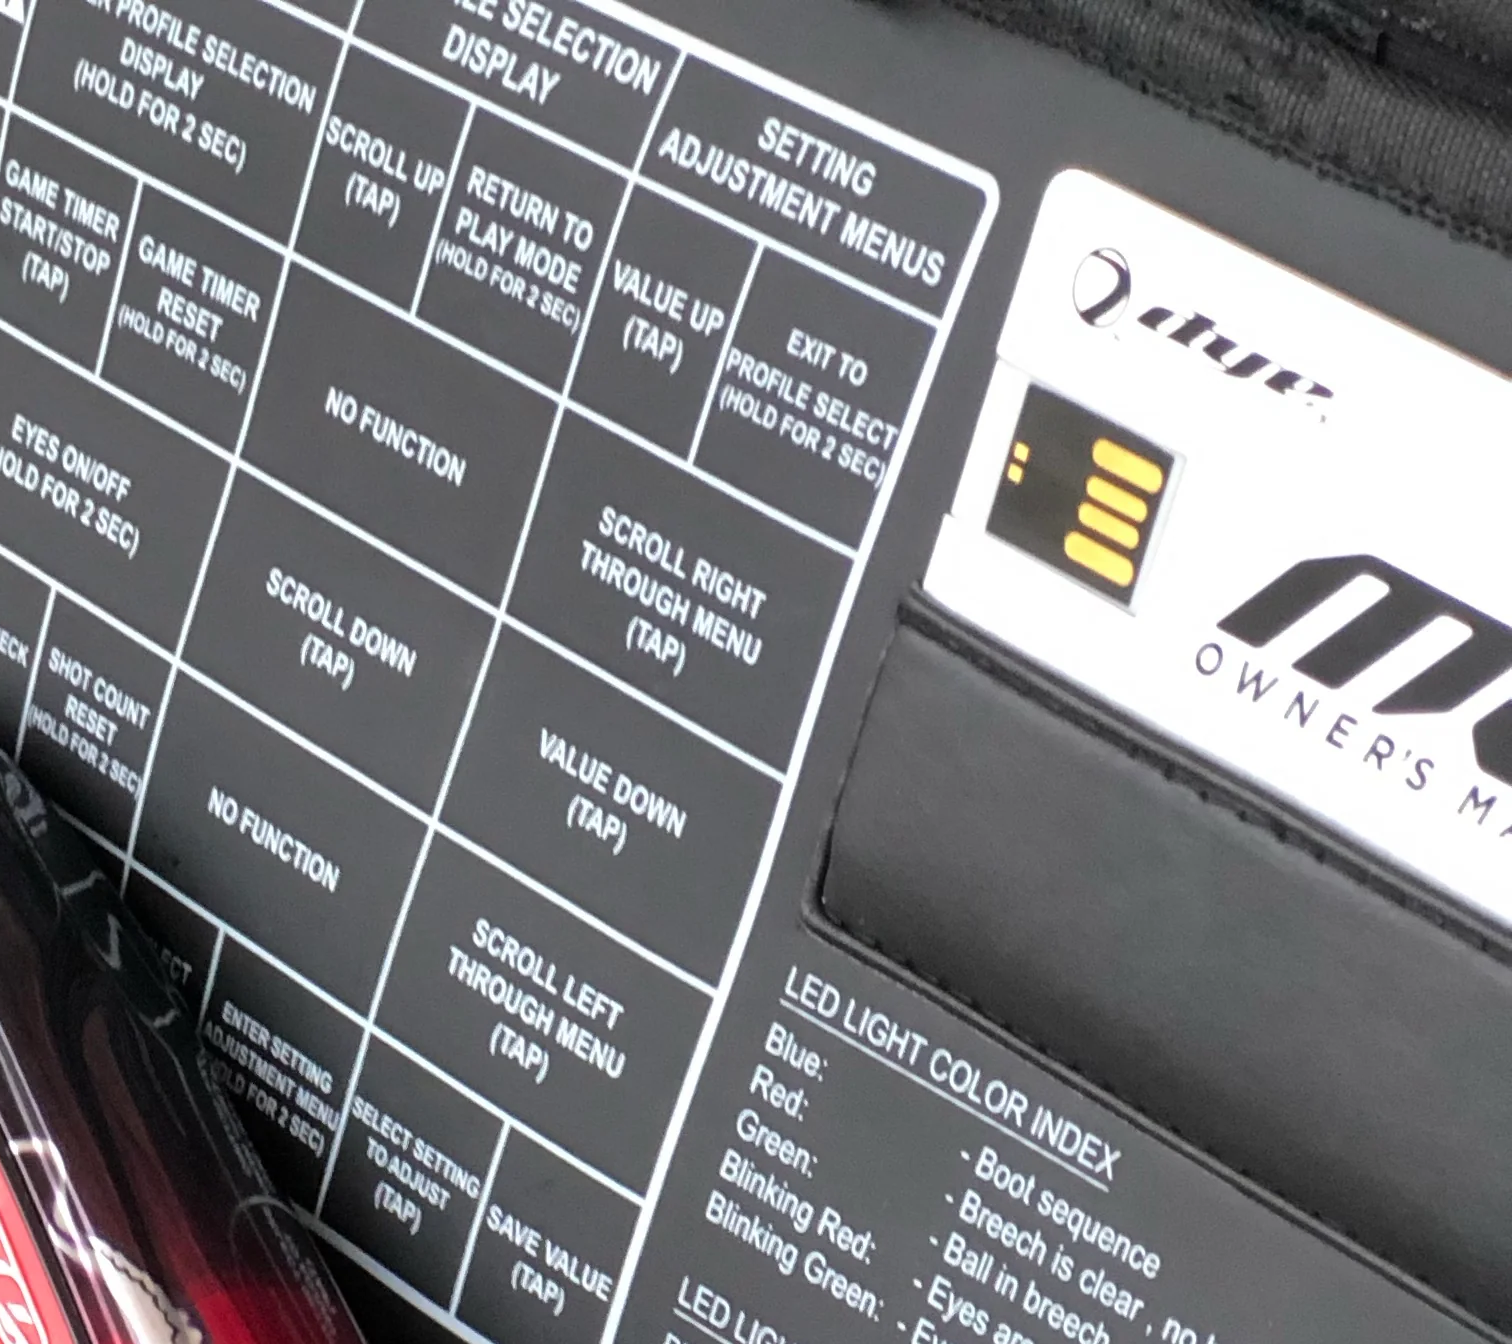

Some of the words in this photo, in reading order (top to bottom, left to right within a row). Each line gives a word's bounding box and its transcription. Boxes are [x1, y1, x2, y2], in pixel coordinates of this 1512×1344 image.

[115, 0, 201, 56] PROFILE
[201, 35, 317, 114] SELECTION
[119, 36, 204, 102] DISPLAY
[442, 24, 561, 105] DISPLAY
[502, 0, 661, 95] SELECTION
[73, 58, 134, 111] (HOLD
[136, 91, 180, 137] FOR
[180, 114, 196, 142] 2
[197, 119, 248, 174] SEC)
[325, 116, 409, 183] SCROLL
[413, 160, 445, 197] UP
[757, 117, 878, 197] SETTING
[0, 197, 111, 276] START/STOP
[5, 159, 58, 210] GAME
[63, 188, 120, 243] TIMER
[345, 172, 400, 228] (TAP)
[467, 166, 558, 234] RETURN
[556, 219, 594, 252] TO
[658, 127, 840, 237] ADJUSTMENT
[838, 214, 946, 287] MENUS
[22, 251, 69, 303] (TAP)
[138, 235, 195, 286] GAME
[199, 264, 261, 322] TIMER
[435, 242, 490, 284] (HOLD
[489, 267, 528, 303] FOR
[540, 291, 582, 334] SEC)
[455, 210, 513, 258] PLAY
[513, 240, 583, 294] MODE
[157, 287, 223, 342] RESET
[613, 260, 690, 323] VALUE
[690, 301, 725, 337] UP
[118, 303, 165, 345] (HOLD
[165, 330, 200, 362] FOR
[208, 353, 247, 395] SEC)
[622, 316, 684, 375] (TAP)
[788, 327, 837, 373] EXIT
[834, 354, 868, 386] TO
[324, 387, 358, 425] NO
[359, 406, 467, 487] FUNCTION
[720, 384, 777, 433] (HOLD
[775, 415, 823, 454] FOR
[821, 441, 835, 460] 2
[836, 444, 888, 489] SEC)
[726, 346, 813, 411] PROFILE
[811, 383, 899, 450] SELECT
[11, 414, 61, 463] EYES
[62, 446, 131, 503] ON/OFF
[40, 474, 80, 517] FOR
[80, 500, 95, 528] 2
[95, 506, 140, 560] SEC)
[580, 539, 690, 627] THROUGH
[692, 611, 762, 666] MENU
[598, 506, 686, 580] SCROLL
[690, 556, 767, 620] RIGHT
[266, 566, 346, 638] SCROLL
[348, 615, 418, 679] DOWN
[299, 631, 355, 691] (TAP)
[626, 615, 686, 676] (TAP)
[47, 647, 92, 692] SHOT
[92, 675, 152, 731] COUNT
[63, 694, 119, 747] RESET
[1195, 642, 1436, 792] OWNER'S
[70, 735, 99, 766] FOR
[108, 760, 145, 800] SEC)
[539, 727, 610, 792] VALUE
[612, 780, 687, 839] DOWN
[207, 786, 239, 827] NO
[238, 806, 341, 894] FUNCTION
[566, 793, 628, 855] (TAP)
[447, 945, 554, 1036] THROUGH
[554, 1018, 627, 1079] MENU
[472, 917, 558, 994] SCROLL
[562, 972, 626, 1031] LEFT
[201, 1020, 300, 1104] ADJUSTMENT
[297, 1085, 341, 1134] MENU
[220, 1000, 271, 1054] ENTER
[270, 1034, 334, 1095] SETTING
[489, 1021, 551, 1084] (TAP)
[764, 1021, 829, 1083] Blue:
[784, 965, 841, 1020] LED
[842, 997, 928, 1066] LIGHT
[928, 1047, 1029, 1127] COLOR
[1030, 1104, 1122, 1182] INDEX
[246, 1083, 279, 1124] FOR
[288, 1113, 326, 1159] SEC)
[748, 1063, 809, 1123] Red:
[350, 1095, 409, 1154] SELECT
[409, 1133, 481, 1200] SETTING
[365, 1136, 390, 1166] TO
[388, 1155, 451, 1212] ADJUST
[735, 1108, 819, 1180] Green:
[372, 1178, 423, 1236] (TAP)
[719, 1148, 815, 1234] Blinking
[816, 1205, 877, 1265] Red:
[973, 1144, 1037, 1208] Boot
[1035, 1188, 1162, 1281] sequence
[486, 1203, 540, 1260] SAVE
[544, 1243, 614, 1302] VALUE
[510, 1258, 566, 1317] (TAP)
[704, 1190, 799, 1276] Blinking
[803, 1250, 886, 1322] Green:
[943, 1231, 994, 1285] Ball
[993, 1261, 1020, 1303] in
[958, 1189, 1048, 1267] Breech
[1049, 1243, 1075, 1284] is
[1078, 1265, 1144, 1322] clear
[676, 1275, 732, 1332] LED
[926, 1274, 990, 1337] Eyes
